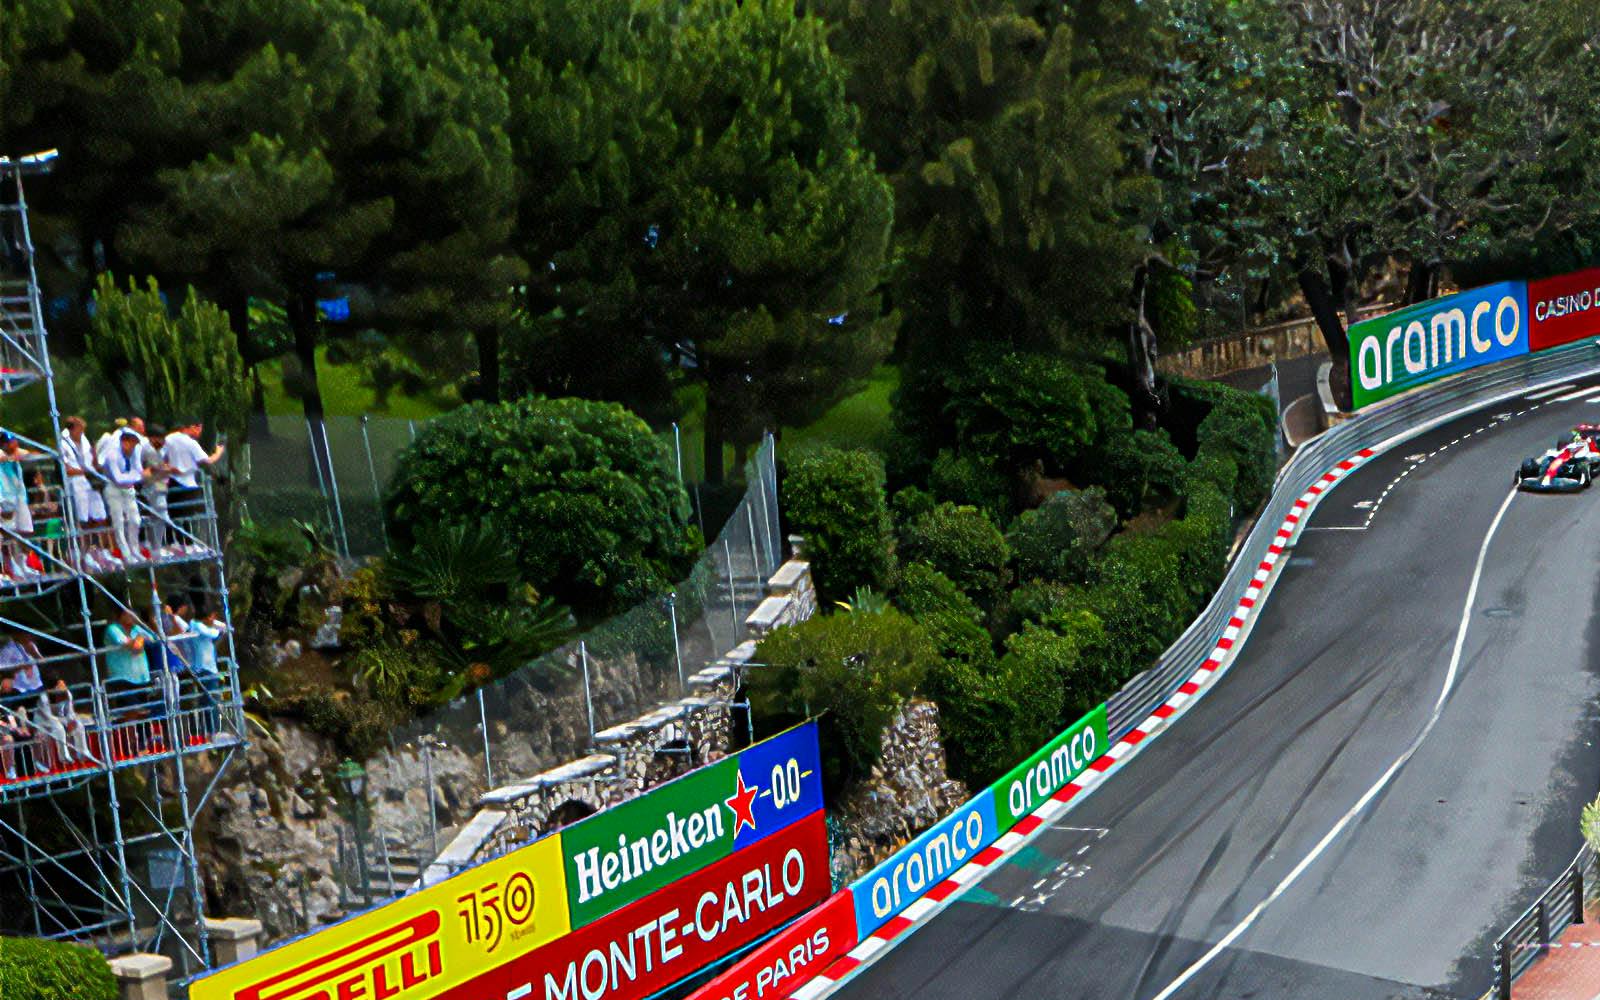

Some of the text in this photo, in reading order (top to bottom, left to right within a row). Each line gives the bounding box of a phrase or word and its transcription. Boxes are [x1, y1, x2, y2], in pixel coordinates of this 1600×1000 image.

[1357, 294, 1521, 391] aramco
[1535, 290, 1592, 322] CASINO
[1008, 725, 1096, 818] aramco
[573, 797, 725, 904] Heineken
[871, 810, 984, 919] aramco
[755, 926, 831, 998] PARIS
